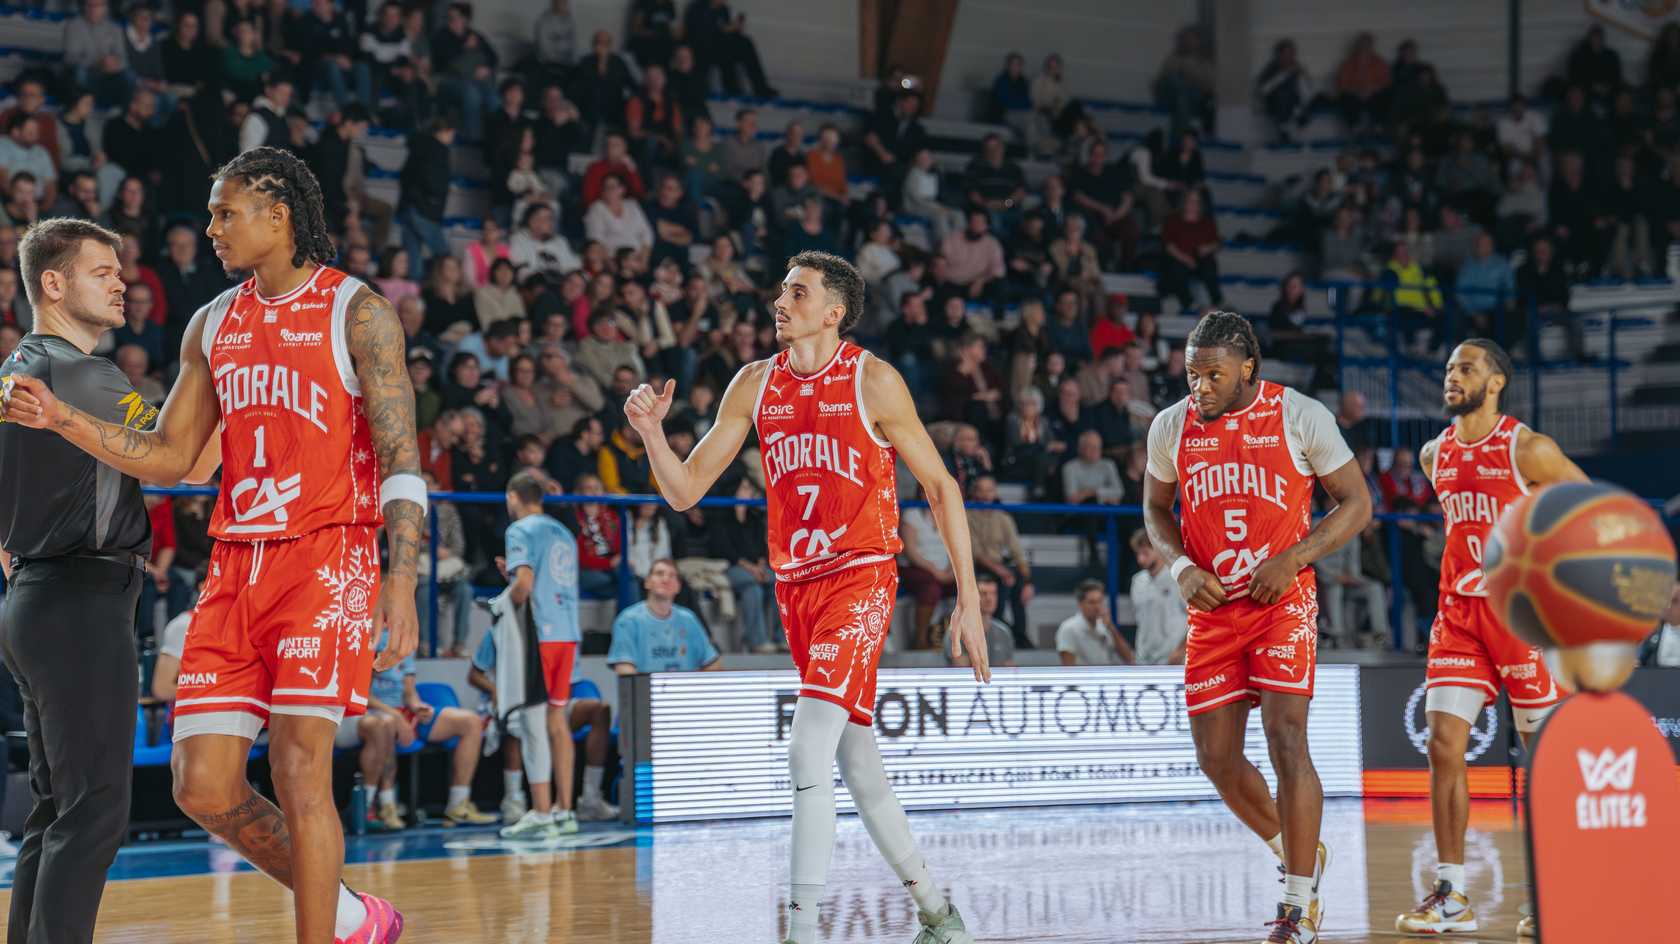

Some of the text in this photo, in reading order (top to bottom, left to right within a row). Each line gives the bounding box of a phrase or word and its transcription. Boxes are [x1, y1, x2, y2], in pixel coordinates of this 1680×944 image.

[216, 332, 253, 345] Loire
[280, 328, 323, 342] Roanne
[762, 404, 794, 415] Loire
[818, 400, 853, 412] Roanne
[1185, 437, 1219, 448] Loire
[1243, 434, 1280, 445] Roanne
[253, 425, 267, 468] 1
[765, 432, 864, 488] CHORALE
[1185, 462, 1288, 513] CHORALE
[797, 485, 820, 521] 7
[1224, 509, 1247, 542] 5
[284, 637, 321, 648] INTER
[283, 648, 320, 659] SPORT
